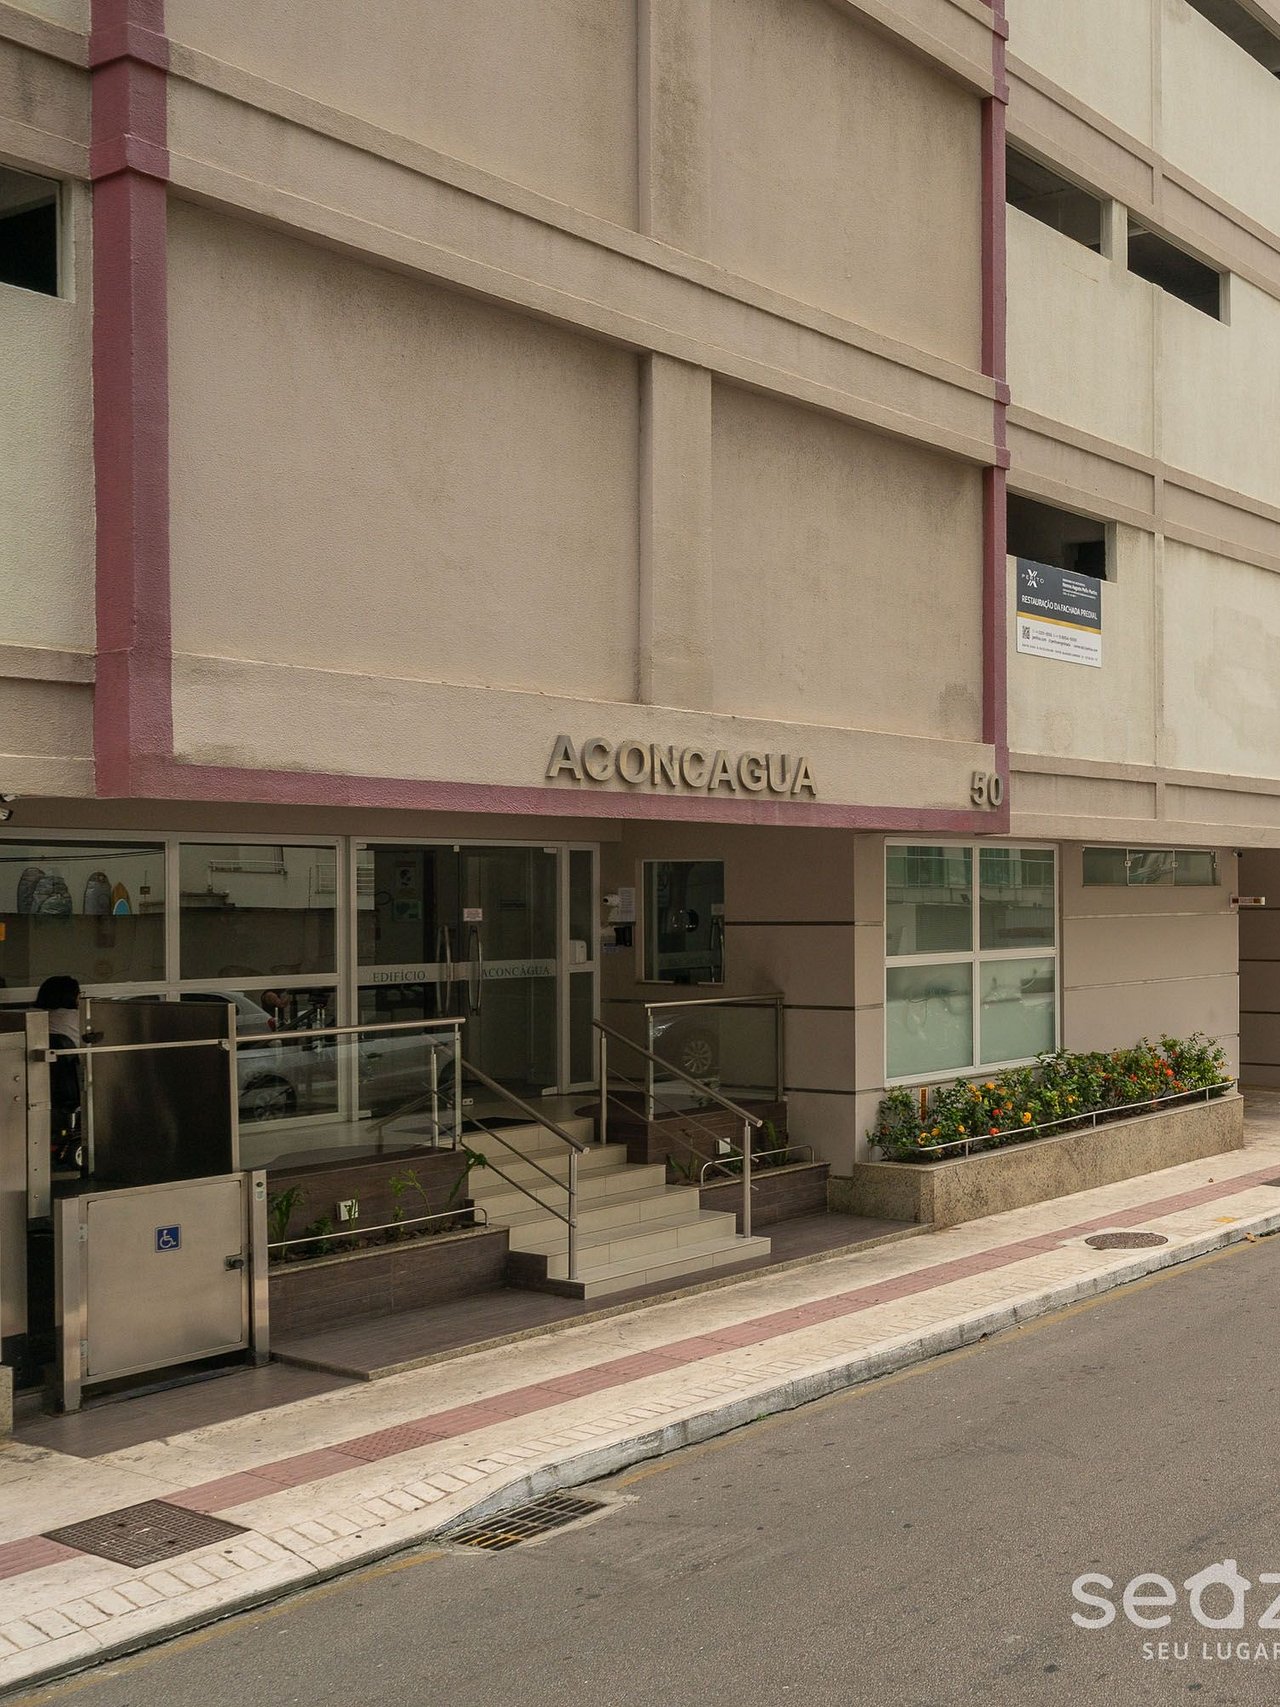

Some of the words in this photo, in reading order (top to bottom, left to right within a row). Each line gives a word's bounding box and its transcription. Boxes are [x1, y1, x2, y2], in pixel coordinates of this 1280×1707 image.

[545, 735, 817, 796] ACONCAGUA
[970, 771, 1004, 806] 50
[373, 970, 426, 982] EDIFÍCIO
